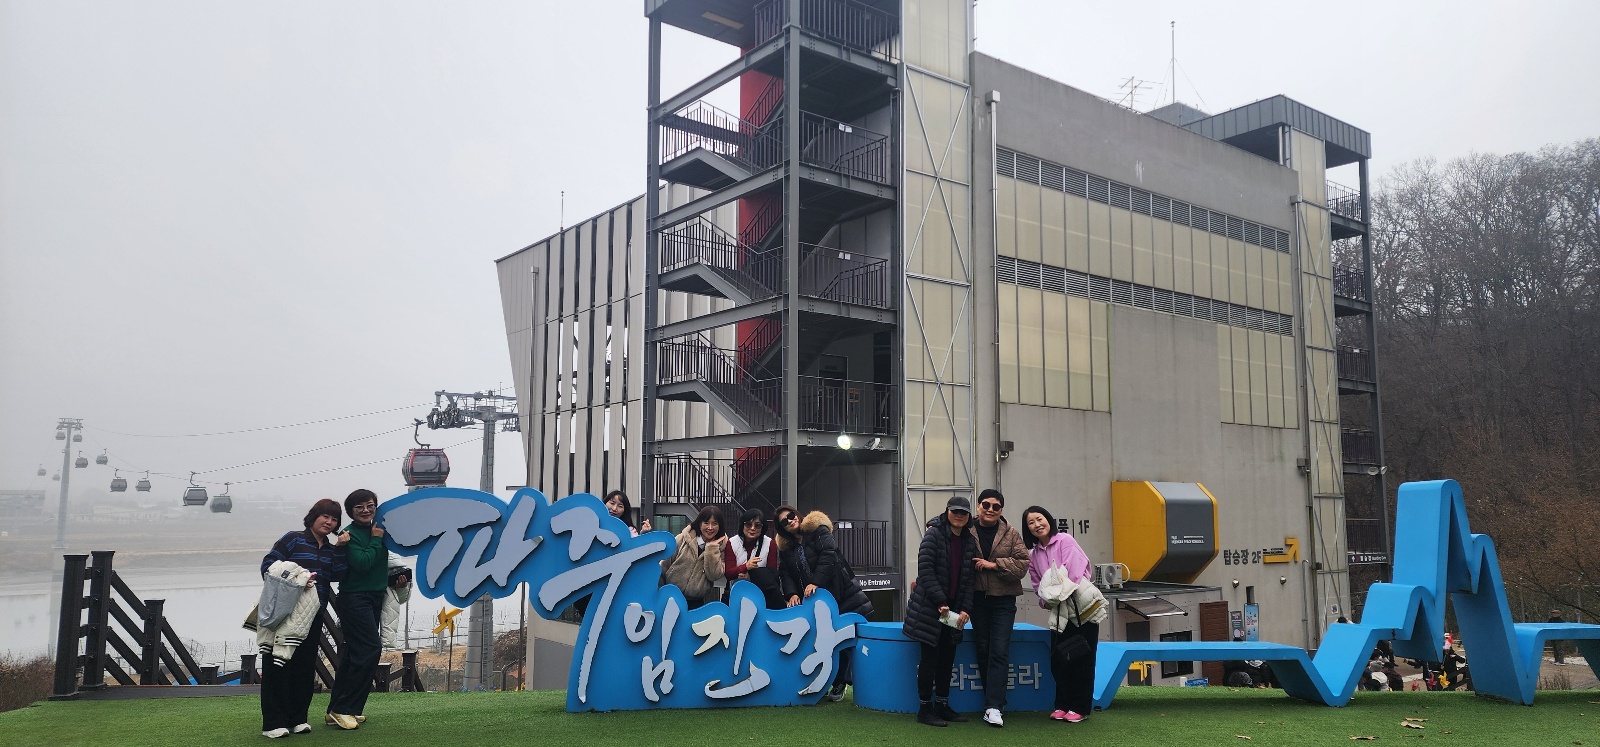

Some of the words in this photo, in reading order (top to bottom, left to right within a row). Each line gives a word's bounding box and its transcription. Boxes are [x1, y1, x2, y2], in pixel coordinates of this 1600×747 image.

[1078, 520, 1090, 534] 1F
[1223, 549, 1249, 565] 탑승장
[1251, 551, 1262, 564] 2F
[859, 579, 867, 587] No
[383, 494, 667, 704] 파주
[624, 596, 857, 703] 임진각
